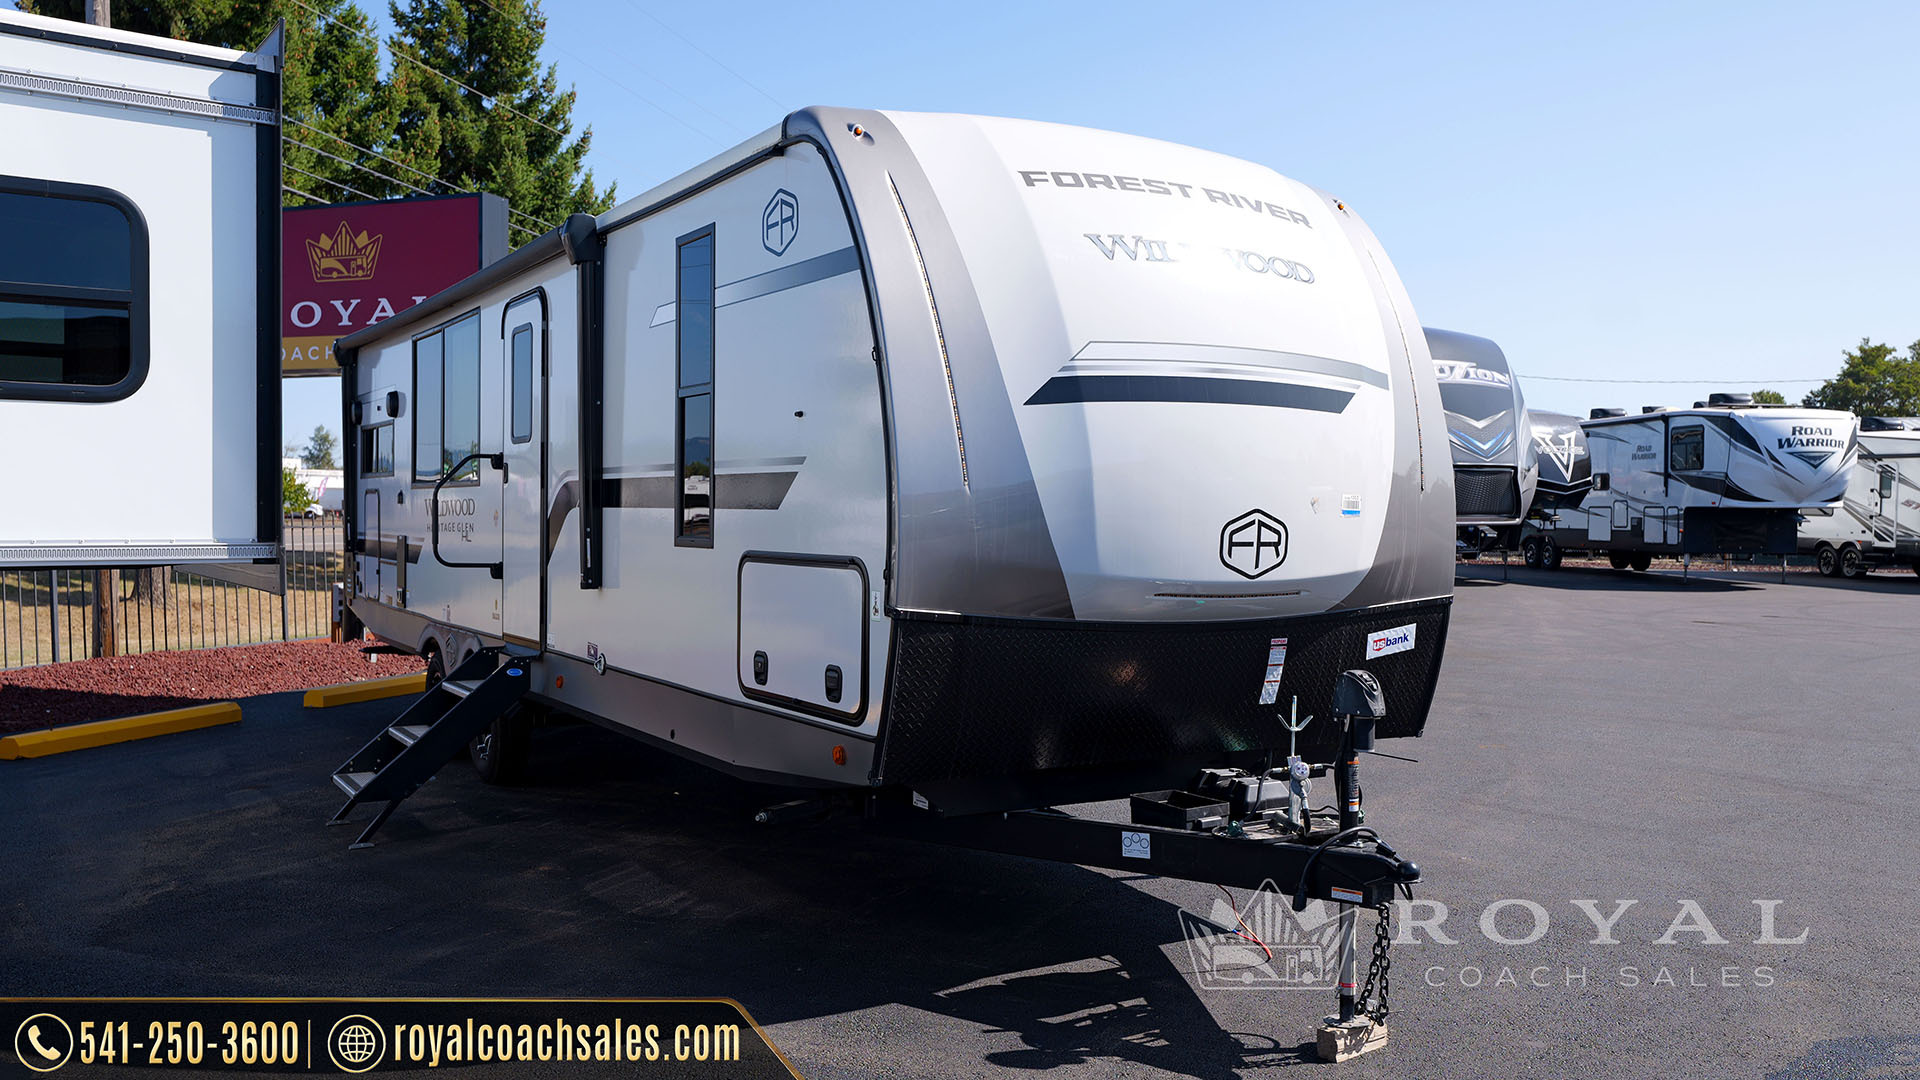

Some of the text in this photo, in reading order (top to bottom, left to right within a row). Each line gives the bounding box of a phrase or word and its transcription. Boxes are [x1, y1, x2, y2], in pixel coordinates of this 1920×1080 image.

[1017, 170, 1313, 229] FOREST RIVER
[1083, 233, 1315, 284] WILOOD
[290, 296, 427, 328] OYA
[1791, 425, 1832, 436] ROAD
[1777, 437, 1845, 450] WARRIOR
[426, 522, 474, 533] HTAGE GLEN
